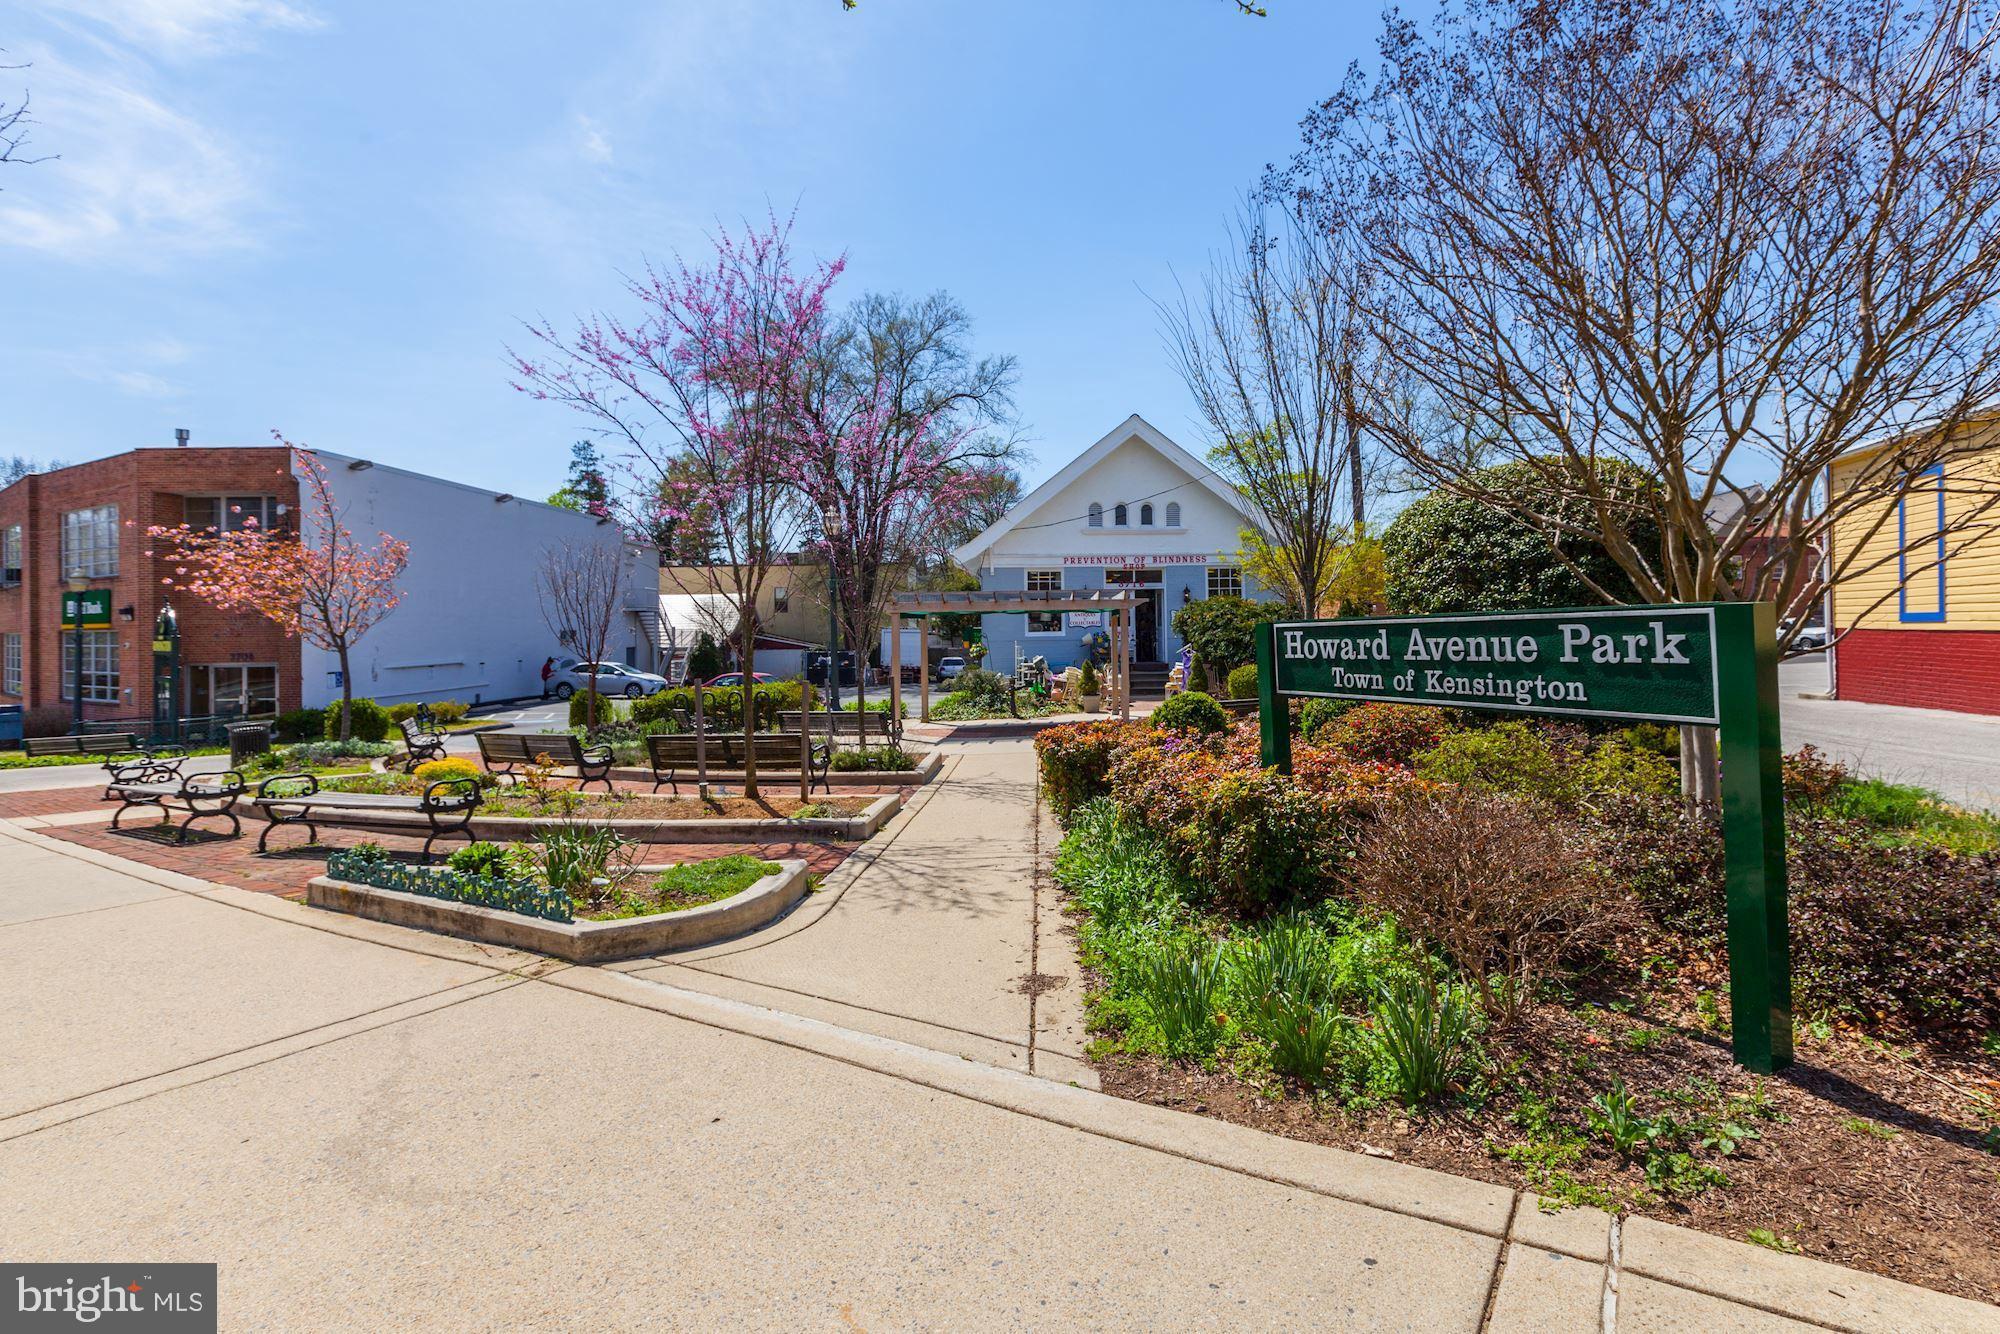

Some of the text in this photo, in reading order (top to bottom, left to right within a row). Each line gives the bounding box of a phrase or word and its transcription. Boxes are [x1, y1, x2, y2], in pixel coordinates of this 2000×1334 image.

[1063, 555, 1207, 564] PREVENTION OF BLINDNESS
[1283, 621, 1690, 664] Howard Avenue Park
[1331, 667, 1588, 705] Town of Kensington
